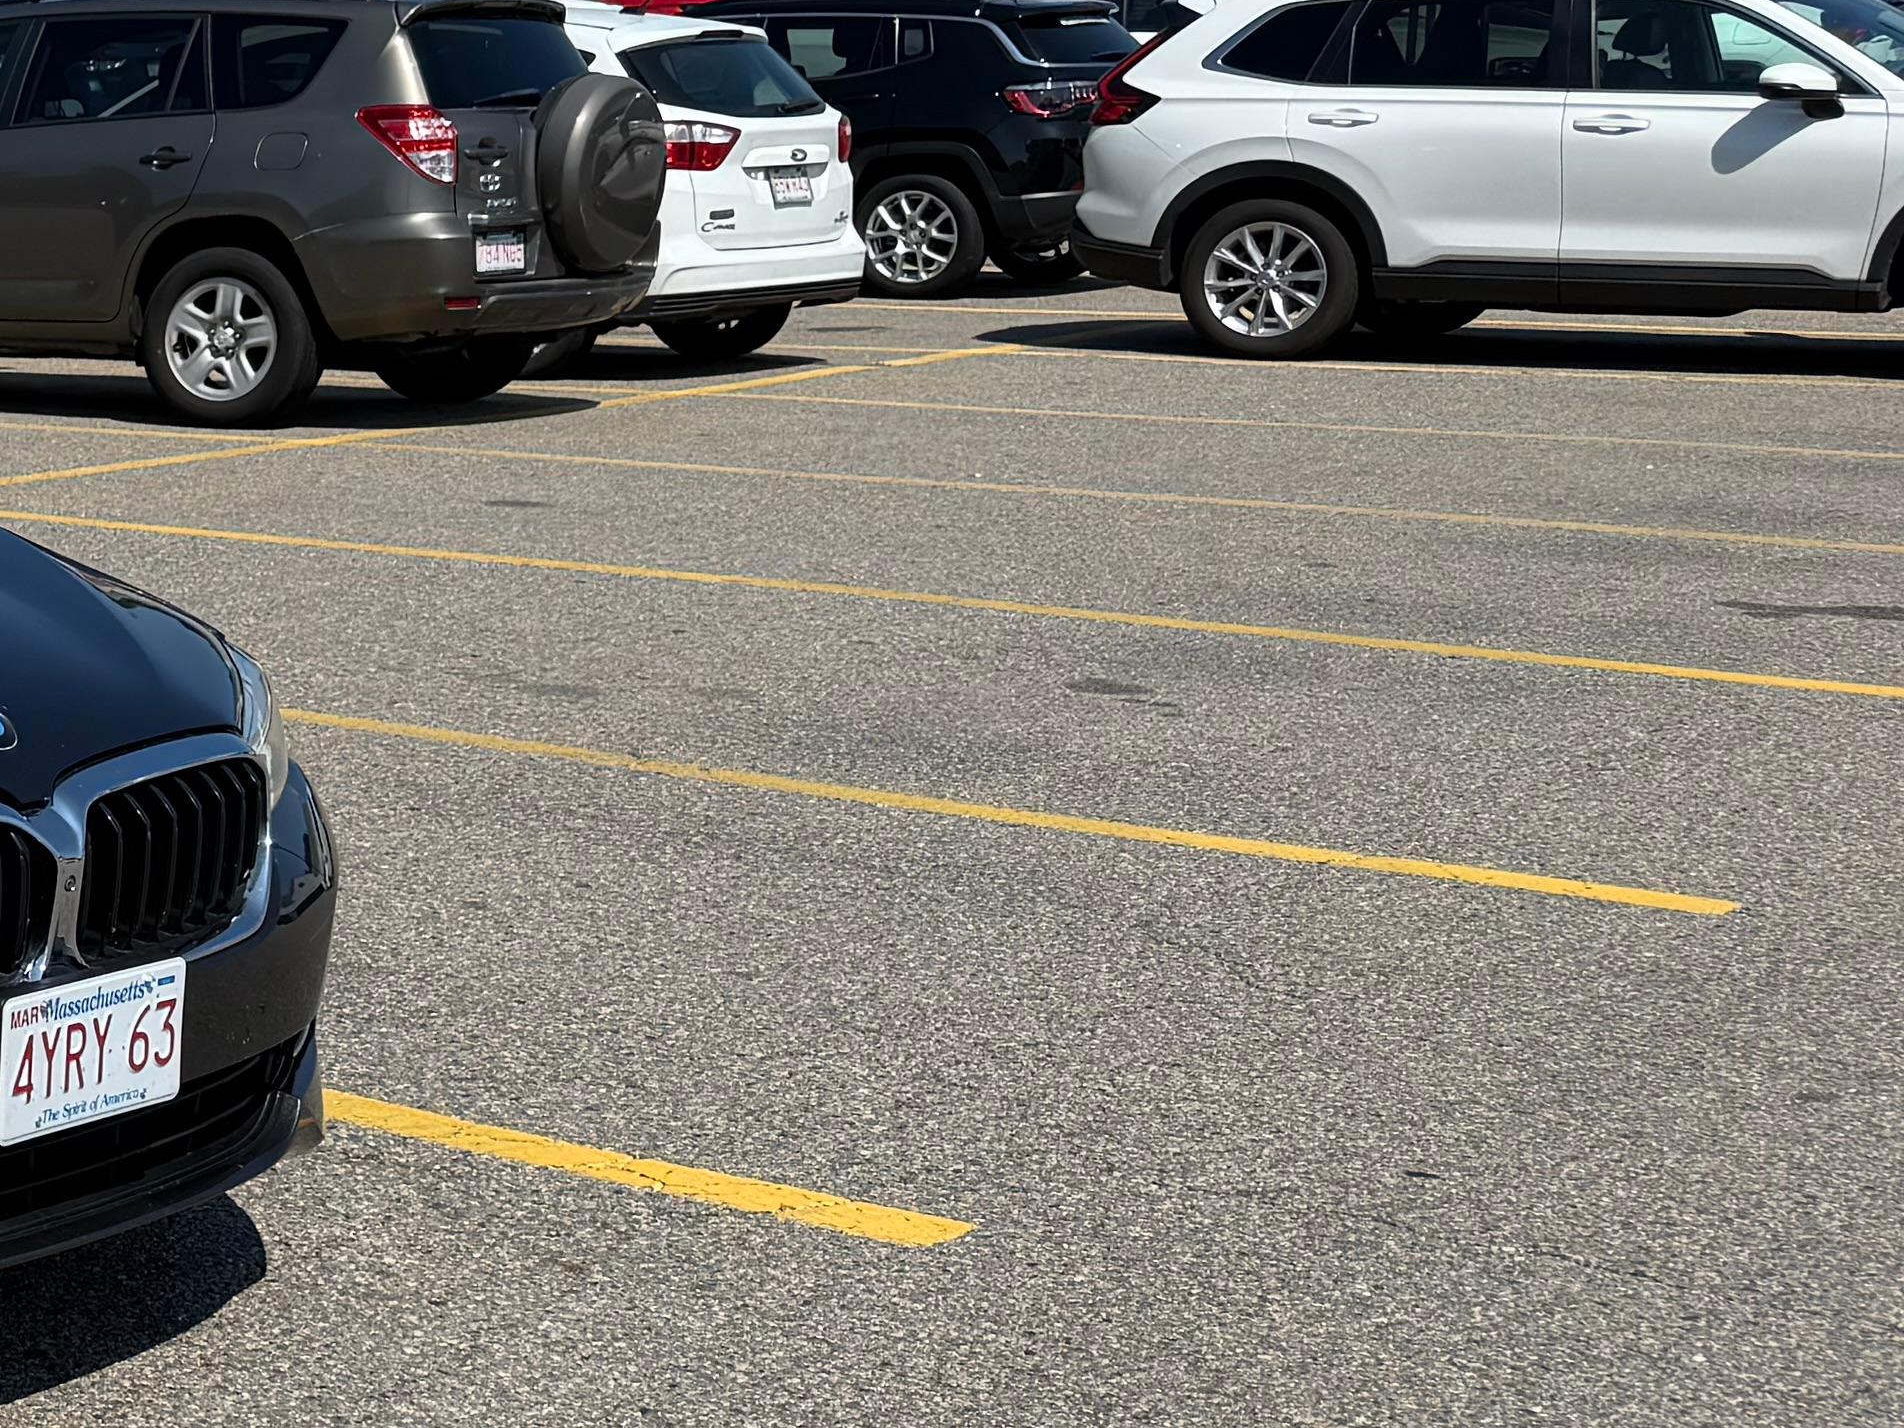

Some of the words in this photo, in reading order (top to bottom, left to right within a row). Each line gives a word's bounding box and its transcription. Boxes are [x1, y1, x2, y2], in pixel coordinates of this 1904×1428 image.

[10, 1006, 39, 1030] MAR
[45, 981, 145, 1022] Massachusetts
[12, 1014, 113, 1104] 4YRY
[128, 998, 177, 1072] 63
[42, 1109, 59, 1124] The
[62, 1101, 86, 1119] Spirit
[88, 1094, 100, 1112] of
[101, 1089, 139, 1108] America
